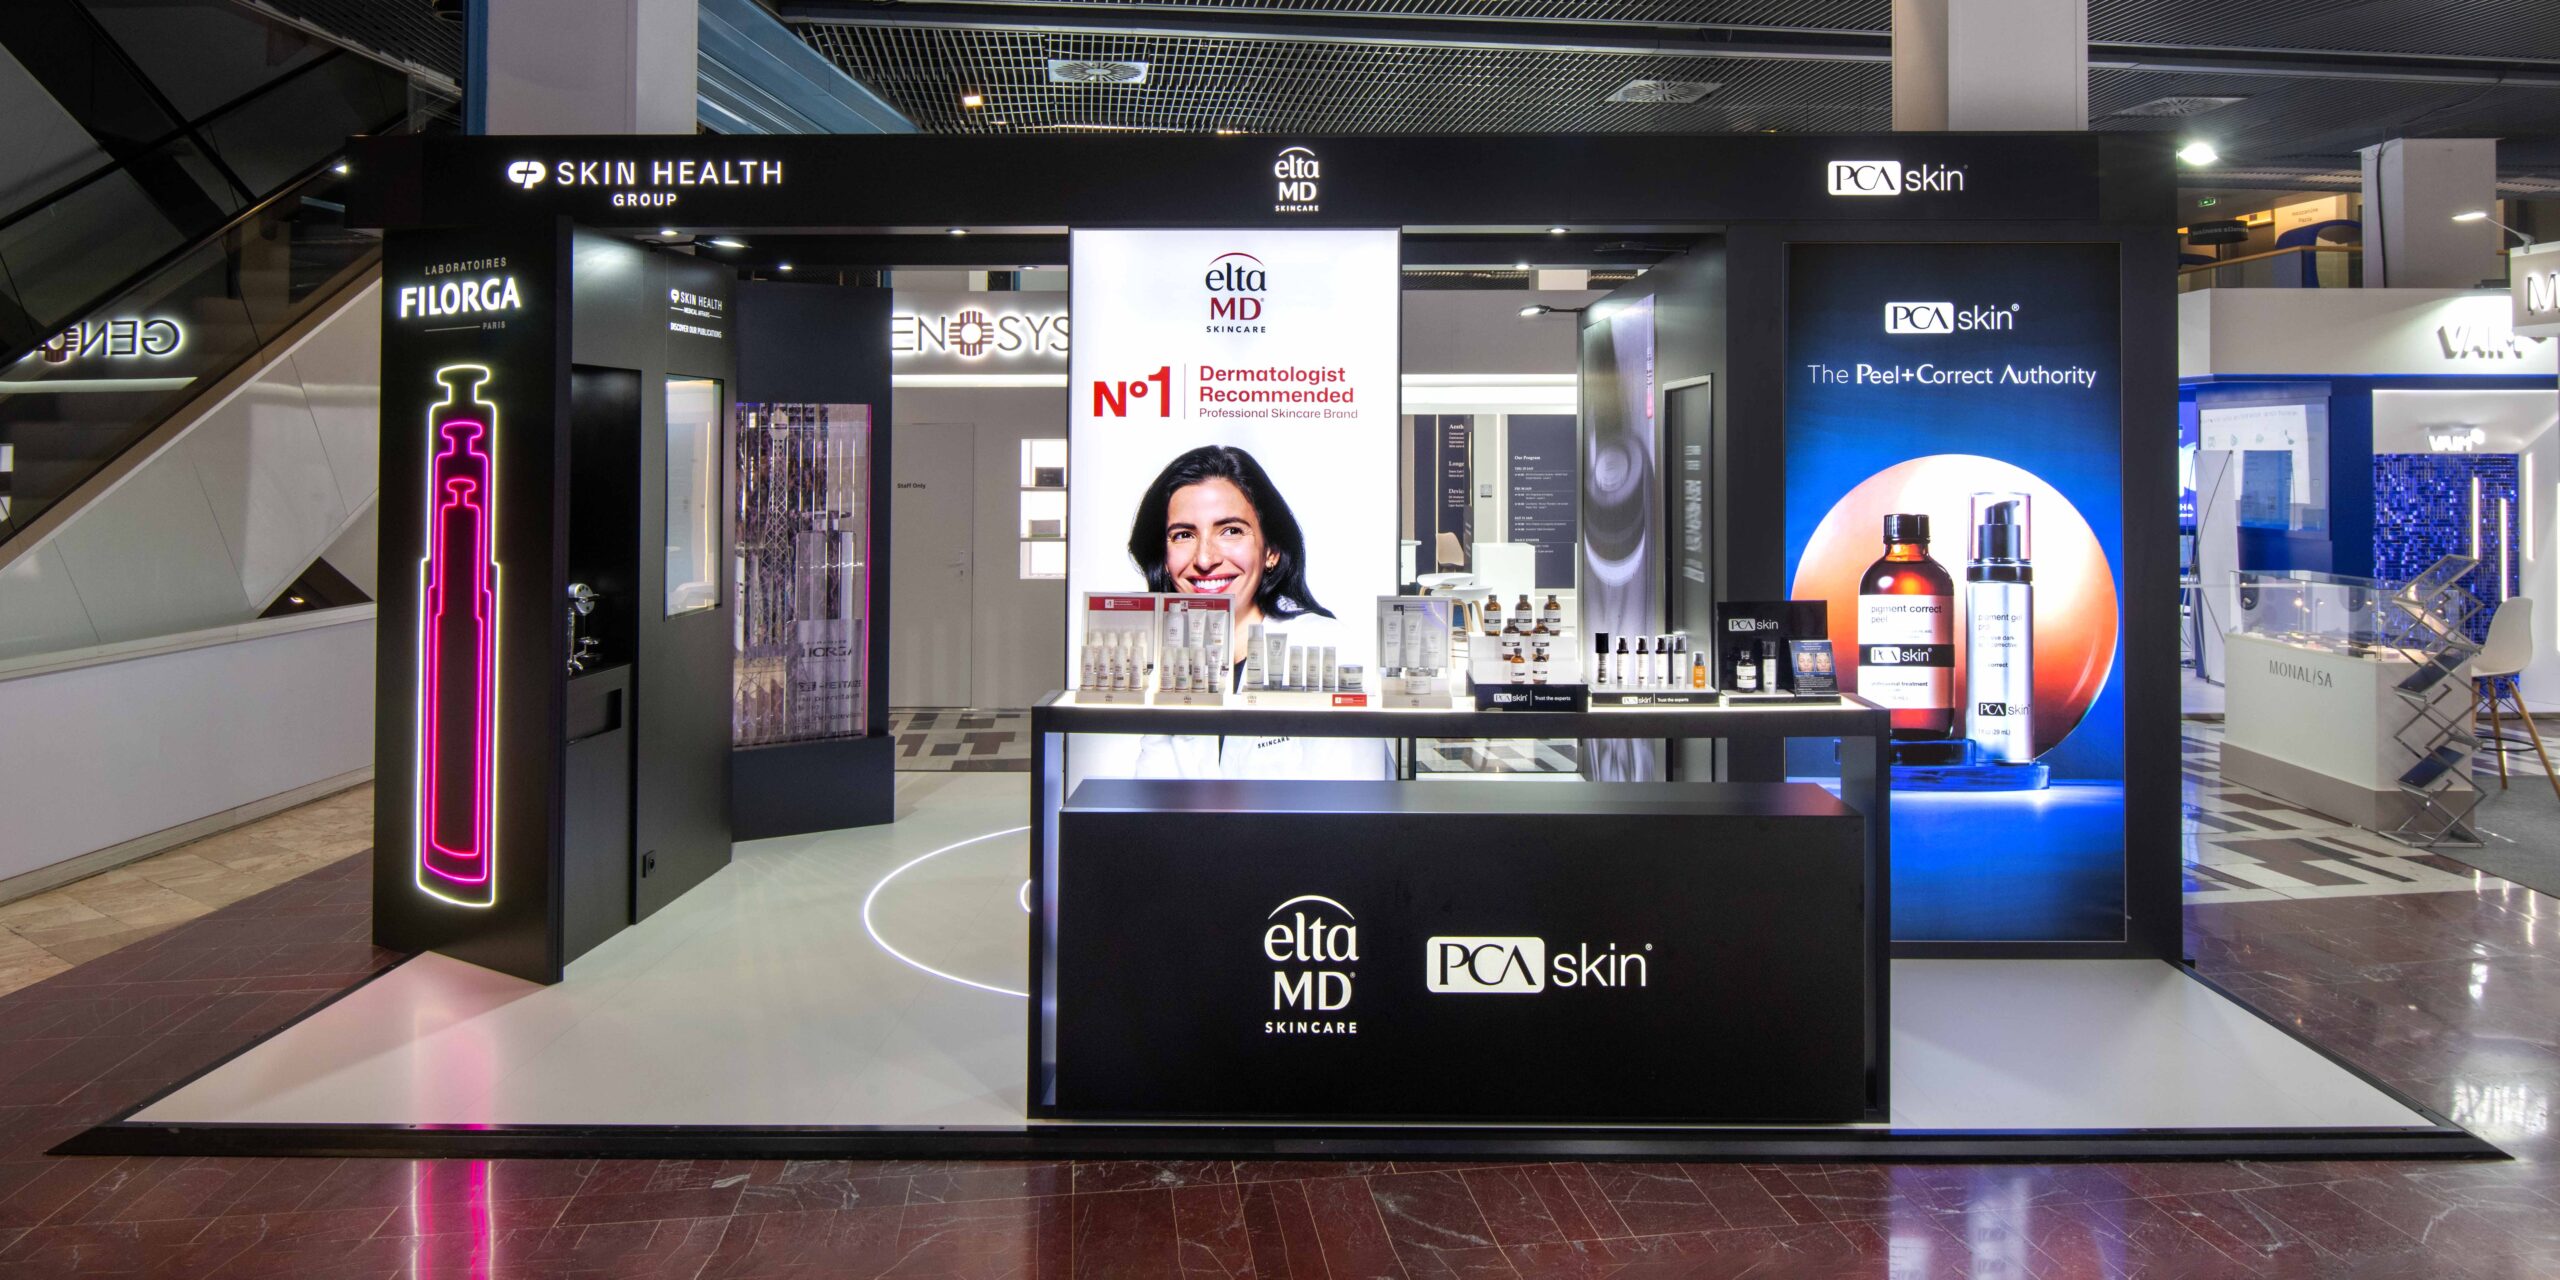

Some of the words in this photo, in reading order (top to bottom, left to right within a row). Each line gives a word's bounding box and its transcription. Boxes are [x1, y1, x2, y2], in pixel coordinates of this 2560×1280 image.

[557, 161, 636, 185] SKIN
[653, 161, 782, 185] HEALTH
[1274, 154, 1320, 179] elta
[1836, 165, 1895, 191] PCA
[612, 193, 678, 207] GROUP
[1278, 182, 1317, 202] MD
[1275, 204, 1319, 212] SKINCARE
[425, 257, 507, 276] LABORATOIRES
[1205, 262, 1267, 292] elta
[400, 277, 521, 318] FILORGA
[680, 291, 696, 305] SKIN
[698, 295, 722, 310] HEALTH
[482, 320, 506, 331] PARIS
[1892, 305, 1949, 330] PCA
[1206, 325, 1266, 334] SKINCARE
[1199, 366, 1346, 386] Dermatologist
[1807, 364, 1849, 385] The
[1856, 363, 1994, 385] Peel+Correct
[2000, 363, 2097, 388] Authority
[1199, 386, 1355, 404] Recommended
[1199, 408, 1269, 419] Professional
[1271, 408, 1321, 419] Skincare
[1323, 408, 1359, 419] Brand
[912, 482, 925, 490] Only
[1871, 605, 1907, 615] pigment
[1909, 605, 1942, 614] correct
[1731, 620, 1755, 631] PCA
[1756, 619, 1779, 630] skin
[1980, 703, 2005, 716] PCA
[1257, 736, 1291, 749] SKINCARE
[1263, 912, 1360, 963] elta
[1439, 943, 1537, 986] PCA
[1264, 1021, 1359, 1034] SKINCARE
